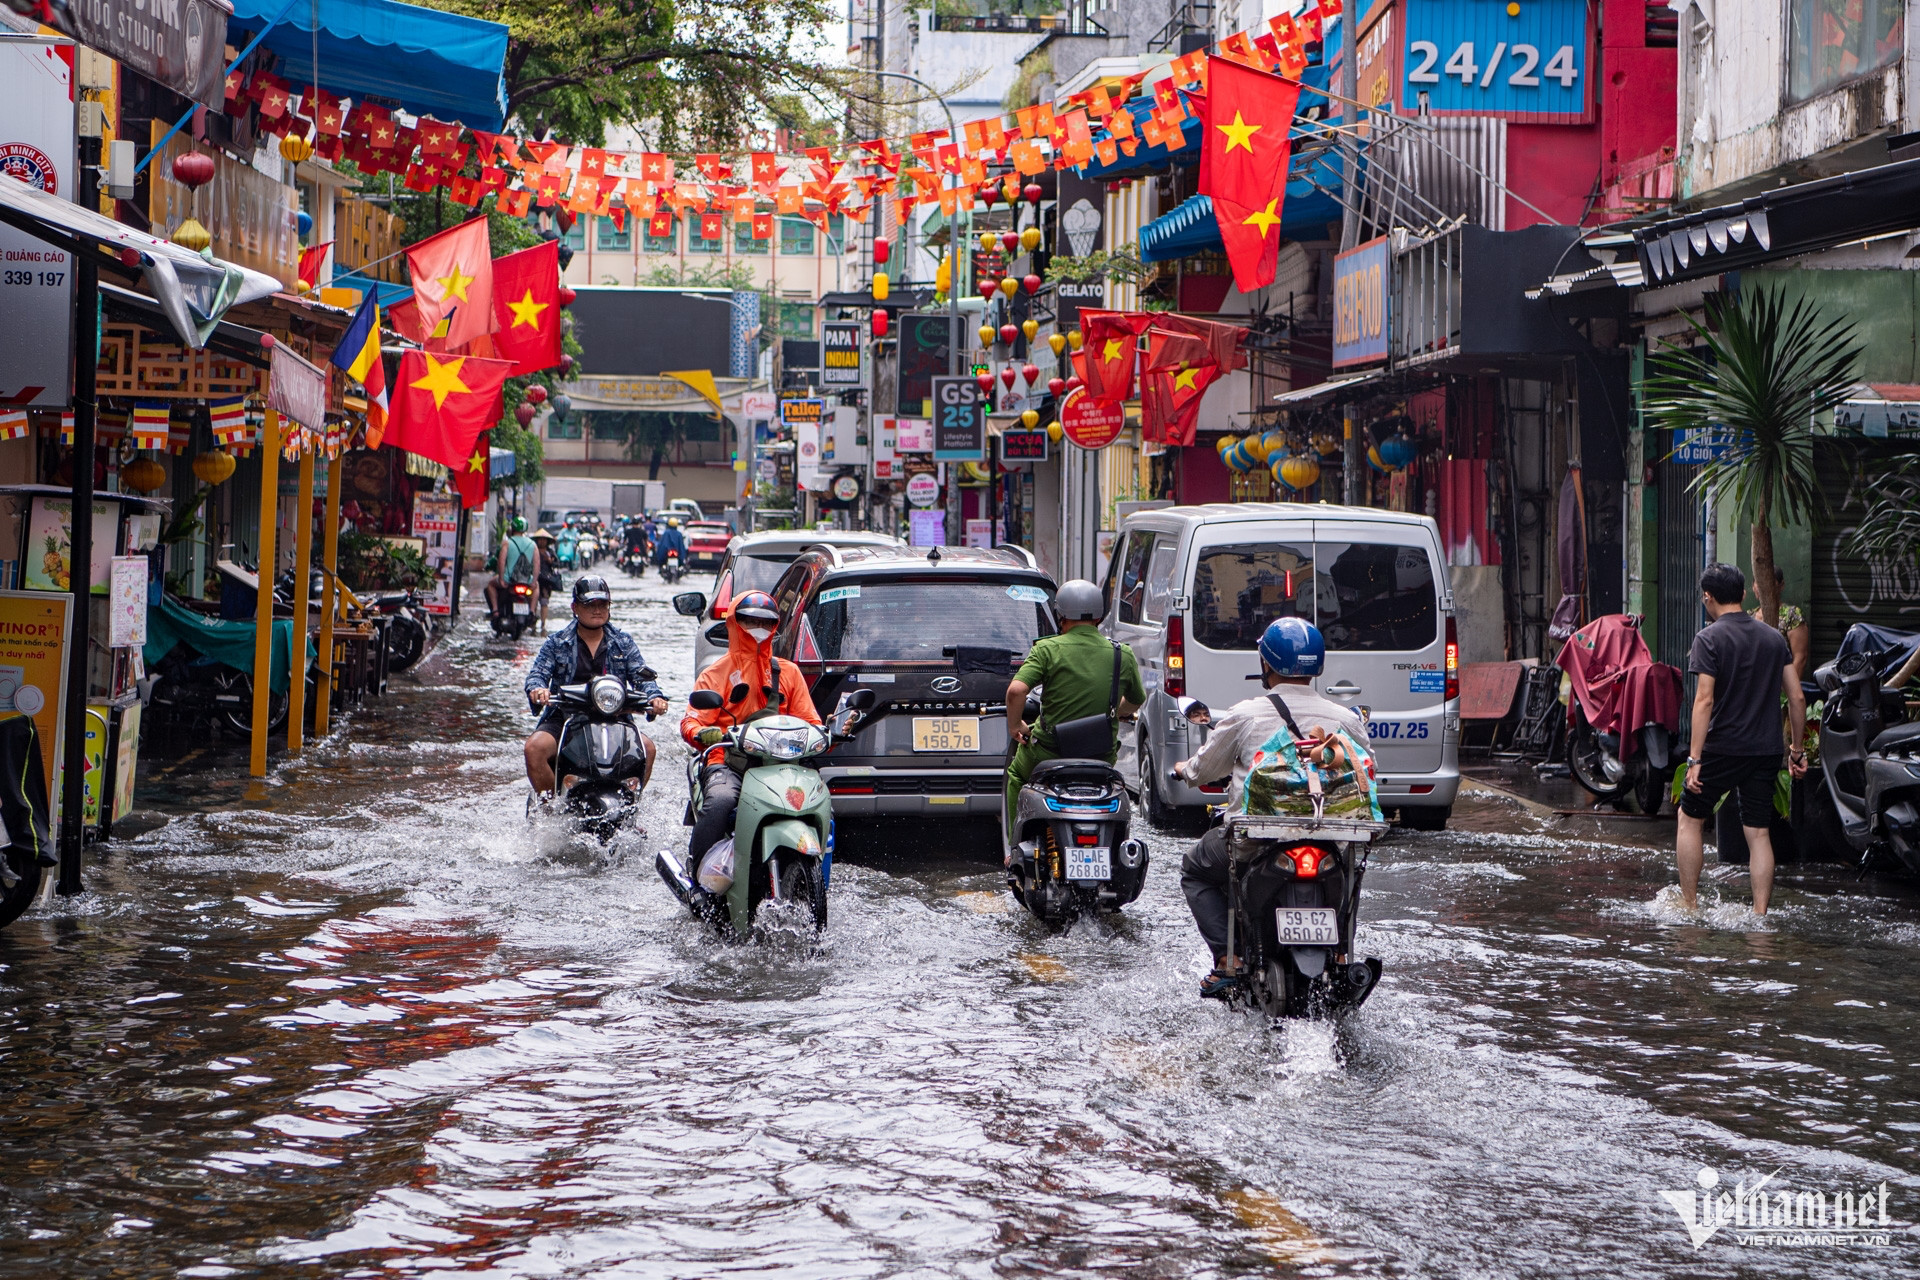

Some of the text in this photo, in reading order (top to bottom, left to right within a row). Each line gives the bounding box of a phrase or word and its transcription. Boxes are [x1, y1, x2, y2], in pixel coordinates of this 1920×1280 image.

[118, 11, 164, 58] STUDIO
[1408, 40, 1578, 88] 24/24
[10, 146, 35, 160] MINH
[36, 155, 53, 175] CITY
[5, 249, 65, 263] QUẢNG CÁO
[4, 271, 65, 286] 339 197
[1058, 284, 1103, 297] GELATO
[1336, 264, 1382, 345] SEAFOOD
[826, 327, 859, 350] PAPAJI
[826, 351, 858, 367] INDIAN
[825, 368, 859, 381] RESTAURANT
[941, 383, 975, 405] GS
[784, 402, 821, 416] Tailor
[943, 406, 974, 428] 25
[944, 433, 973, 441] Lifestyle
[1679, 446, 1691, 461] LỘ
[821, 593, 828, 601] XE
[6, 650, 23, 659] duy
[25, 651, 46, 659] nhất
[932, 720, 959, 733] 50E
[1367, 722, 1428, 739] 307.25
[923, 735, 972, 748] 158.78
[1071, 850, 1105, 863] 50-AE
[1069, 864, 1108, 877] 268.86
[1286, 912, 1327, 925] 59-G2
